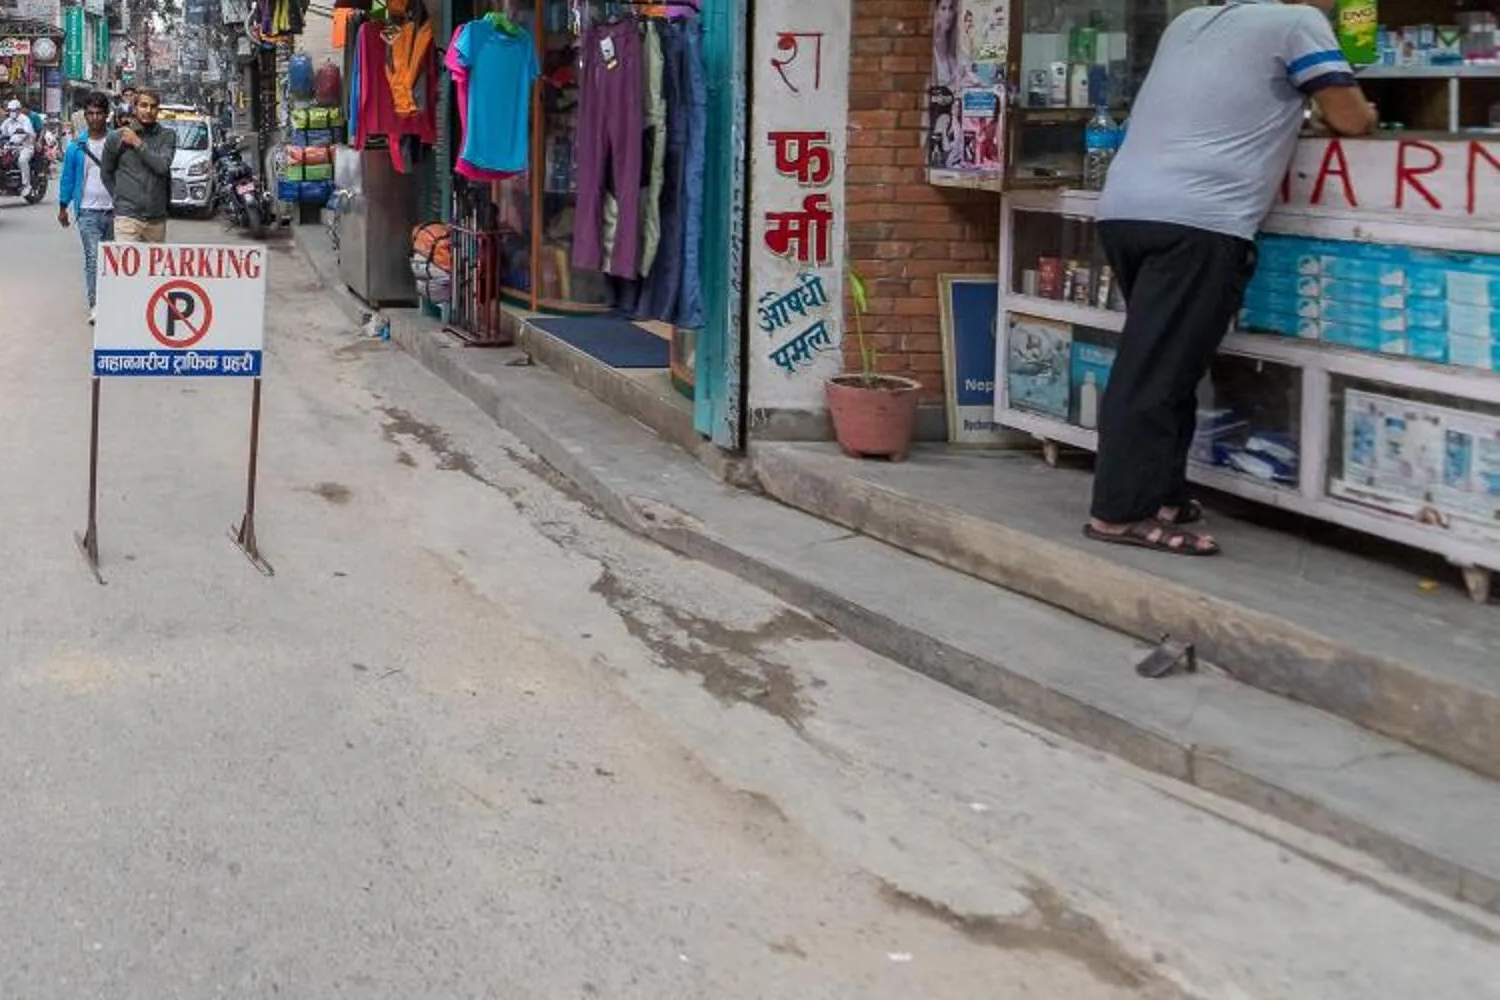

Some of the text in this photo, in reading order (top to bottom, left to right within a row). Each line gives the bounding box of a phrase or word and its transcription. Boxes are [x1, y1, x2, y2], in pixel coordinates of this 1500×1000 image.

[102, 245, 261, 279] NO PARKING
[166, 291, 195, 336] P
